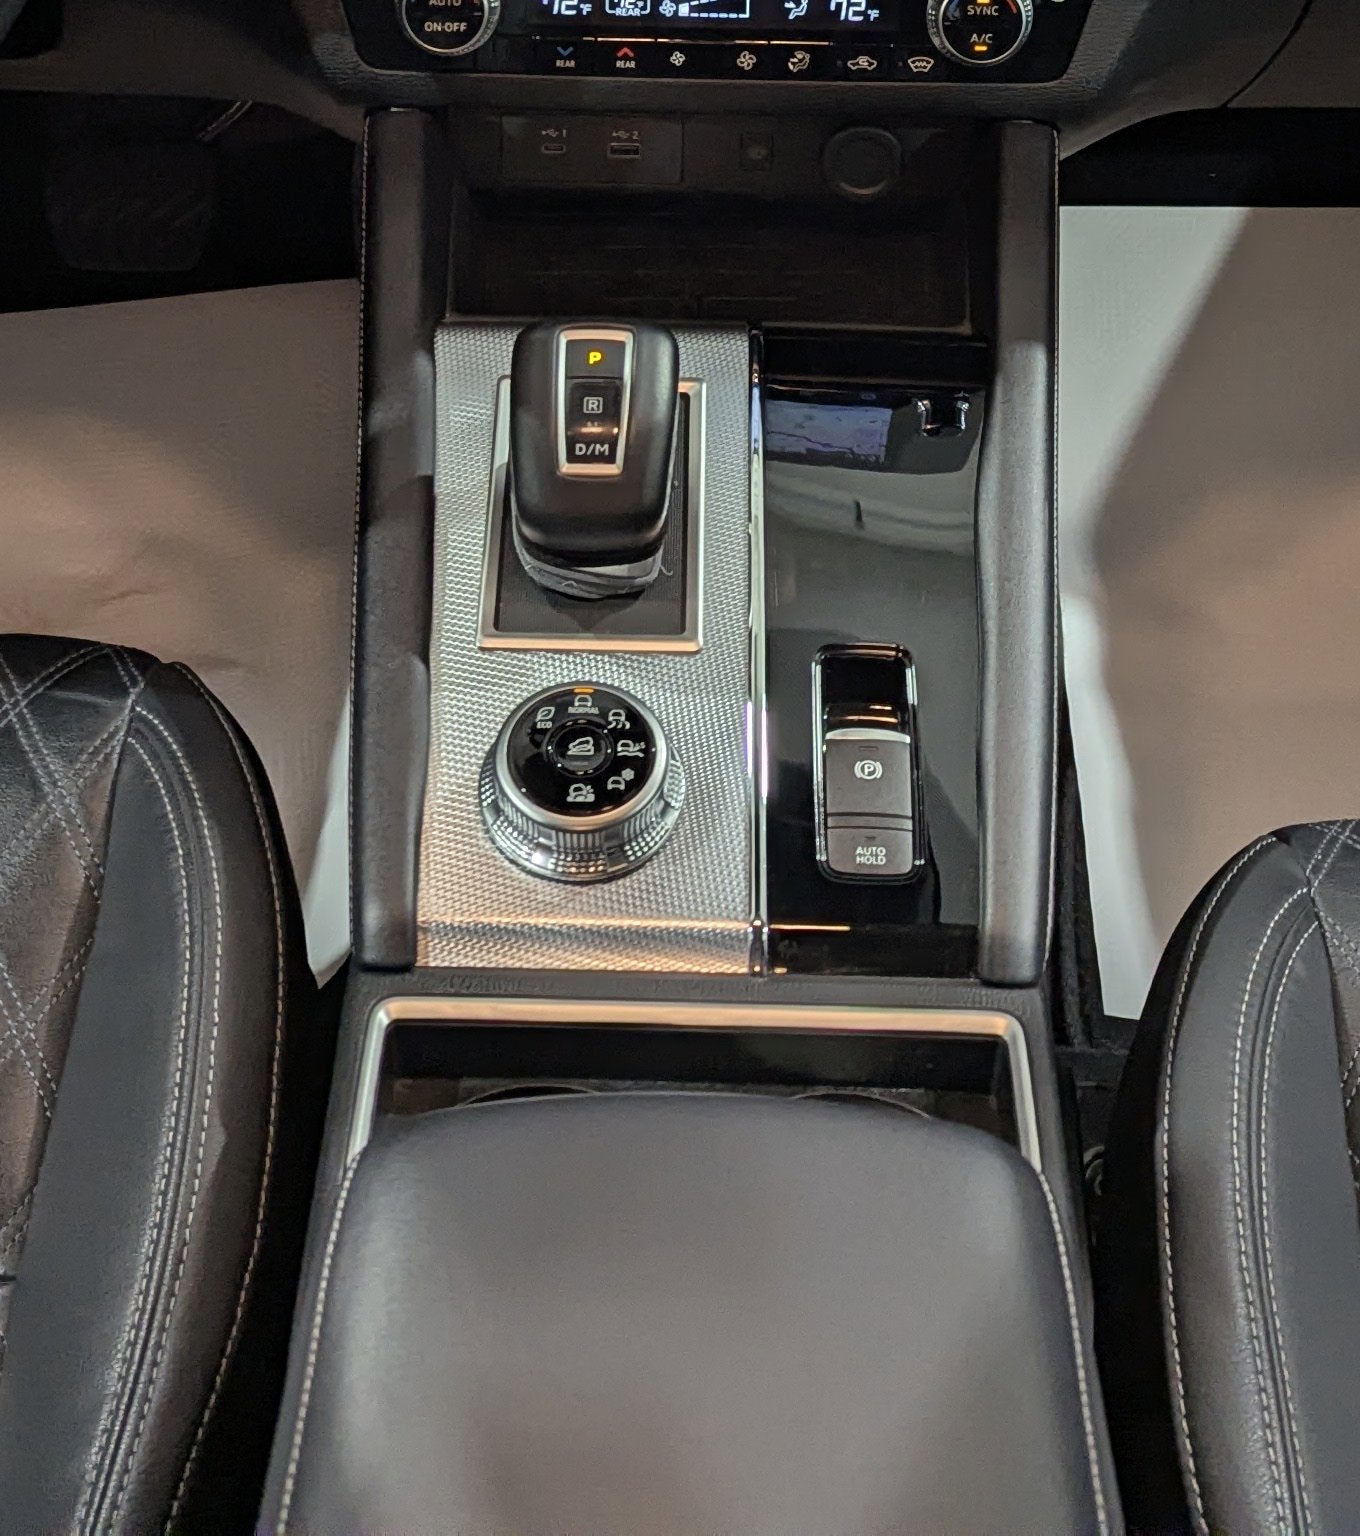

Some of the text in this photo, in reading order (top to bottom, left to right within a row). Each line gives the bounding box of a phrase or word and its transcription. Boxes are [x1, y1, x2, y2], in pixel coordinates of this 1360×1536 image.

[615, 7, 641, 16] REAR
[967, 5, 999, 16] SYNC
[970, 33, 993, 43] A/C
[555, 59, 576, 68] REAR
[616, 60, 636, 68] REAR
[589, 351, 602, 364] P
[575, 443, 610, 456] D/M
[568, 706, 600, 714] NORMAL
[536, 721, 553, 729] ECO
[855, 846, 886, 855] AUTO
[855, 855, 886, 865] HOLD
